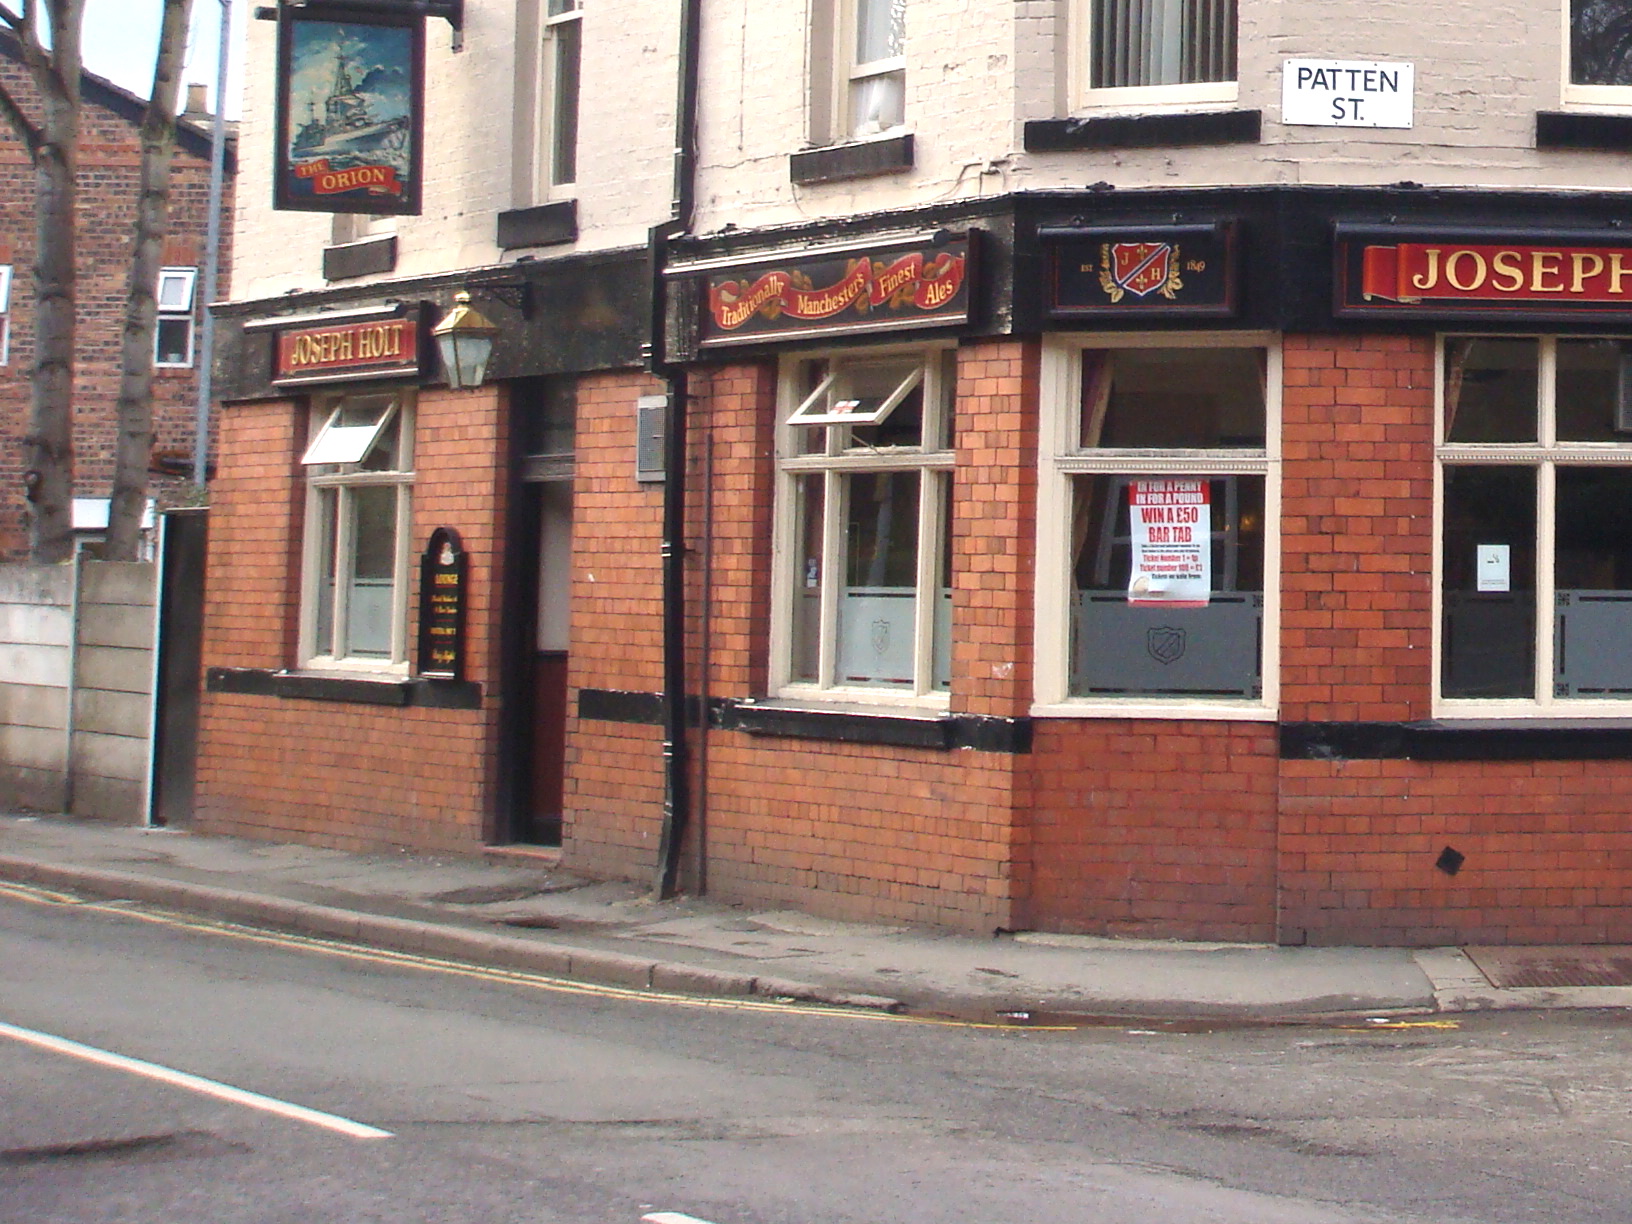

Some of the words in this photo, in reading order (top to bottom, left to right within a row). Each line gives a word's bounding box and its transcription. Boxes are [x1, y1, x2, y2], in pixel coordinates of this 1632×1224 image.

[1298, 66, 1398, 93] PATTEN
[1331, 97, 1365, 121] ST.
[300, 162, 324, 176] THE
[322, 168, 386, 190] ORION
[1150, 267, 1161, 281] H
[1186, 260, 1206, 273] 1849
[721, 275, 785, 326] Traditionally
[879, 262, 917, 298] Finest
[925, 279, 954, 305] Ales
[291, 330, 354, 365] JOSEPH
[358, 324, 403, 359] HOLT
[1149, 481, 1165, 492] FOR
[1166, 481, 1173, 492] A
[1174, 481, 1202, 492] PENNY
[1136, 493, 1146, 504] IN
[1148, 493, 1165, 504] FOR
[1166, 493, 1172, 504] A
[1173, 493, 1204, 504] POUND
[1141, 507, 1164, 523] WIN
[1167, 507, 1174, 523] A
[1177, 507, 1198, 523] £50
[1149, 527, 1169, 542] BAR
[1172, 527, 1191, 542] TAB
